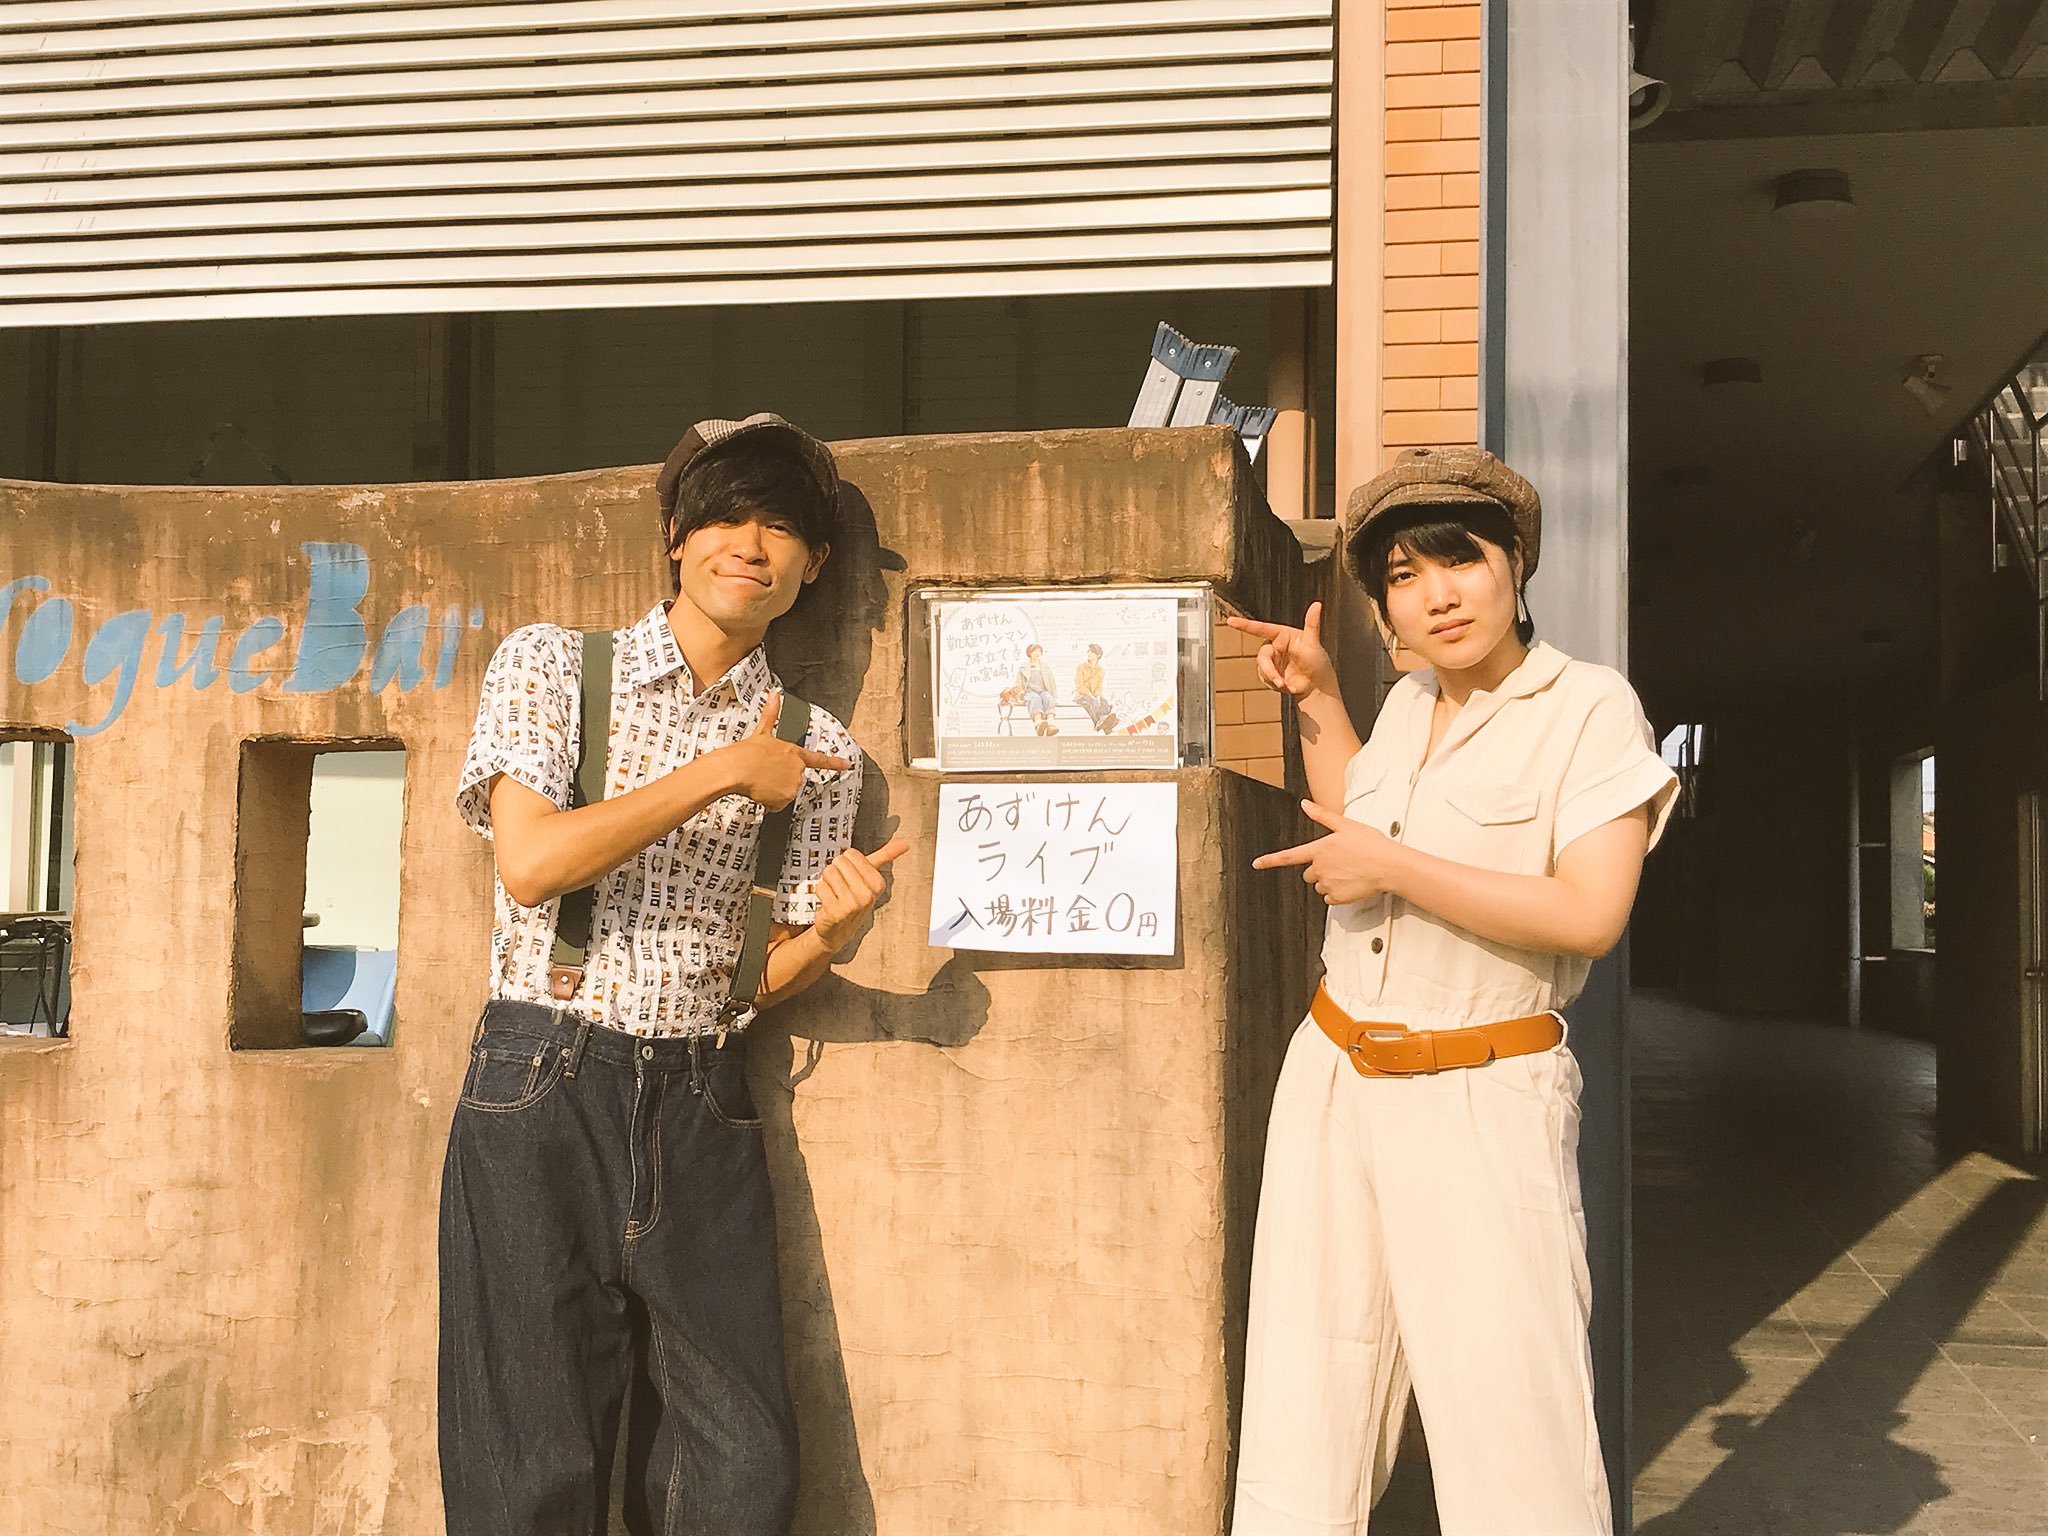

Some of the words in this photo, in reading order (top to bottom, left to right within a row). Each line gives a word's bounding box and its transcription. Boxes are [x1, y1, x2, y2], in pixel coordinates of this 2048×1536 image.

[945, 629, 1029, 651] 凱旋ワンマン
[961, 612, 1013, 631] あずけん
[958, 792, 1133, 835] あずけん
[978, 841, 1114, 885] ライブ
[949, 892, 1158, 937] 入場料金0円
